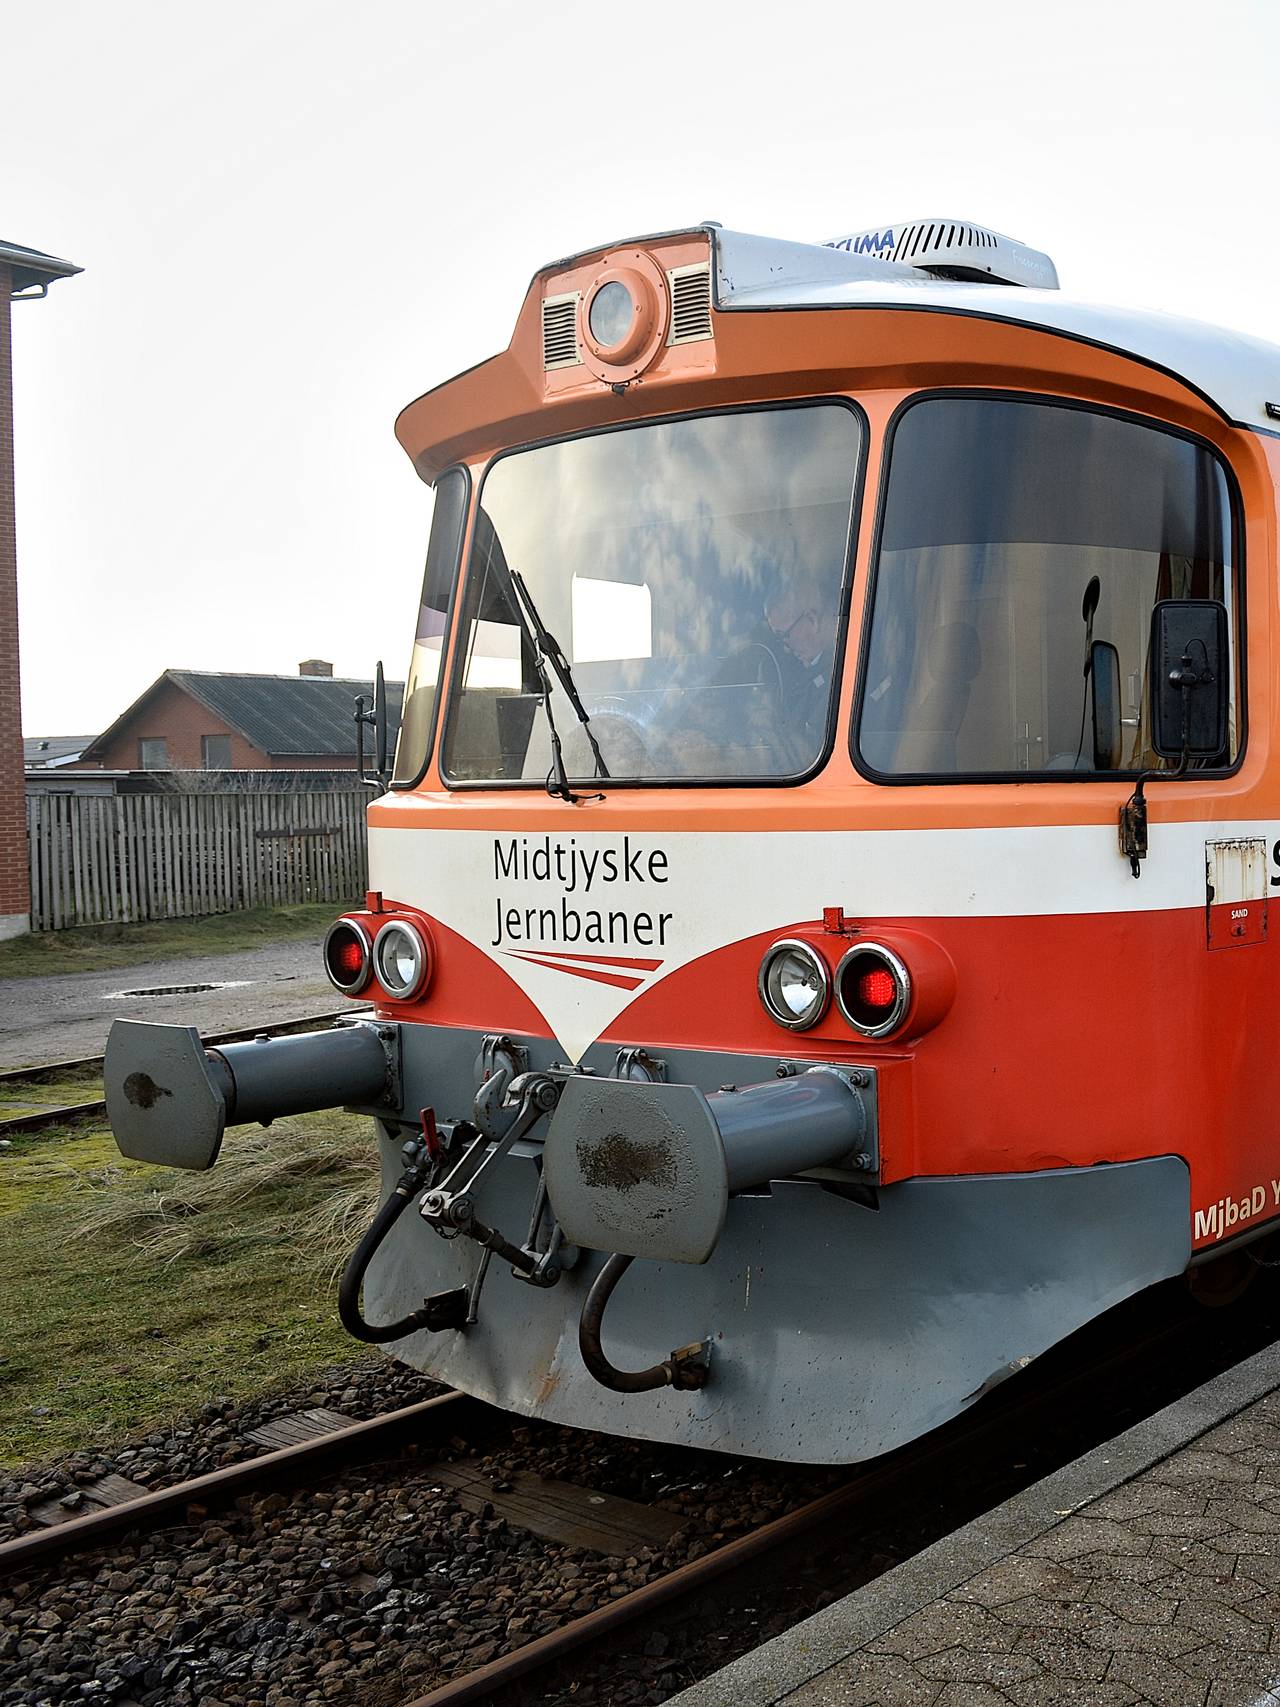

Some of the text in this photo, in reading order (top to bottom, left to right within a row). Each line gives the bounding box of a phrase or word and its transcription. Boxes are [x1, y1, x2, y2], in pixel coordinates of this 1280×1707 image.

[493, 836, 669, 893] Midtjyske
[491, 897, 673, 946] Jernbaner
[1231, 908, 1248, 920] SAND
[1193, 1185, 1266, 1240] MjbaD
